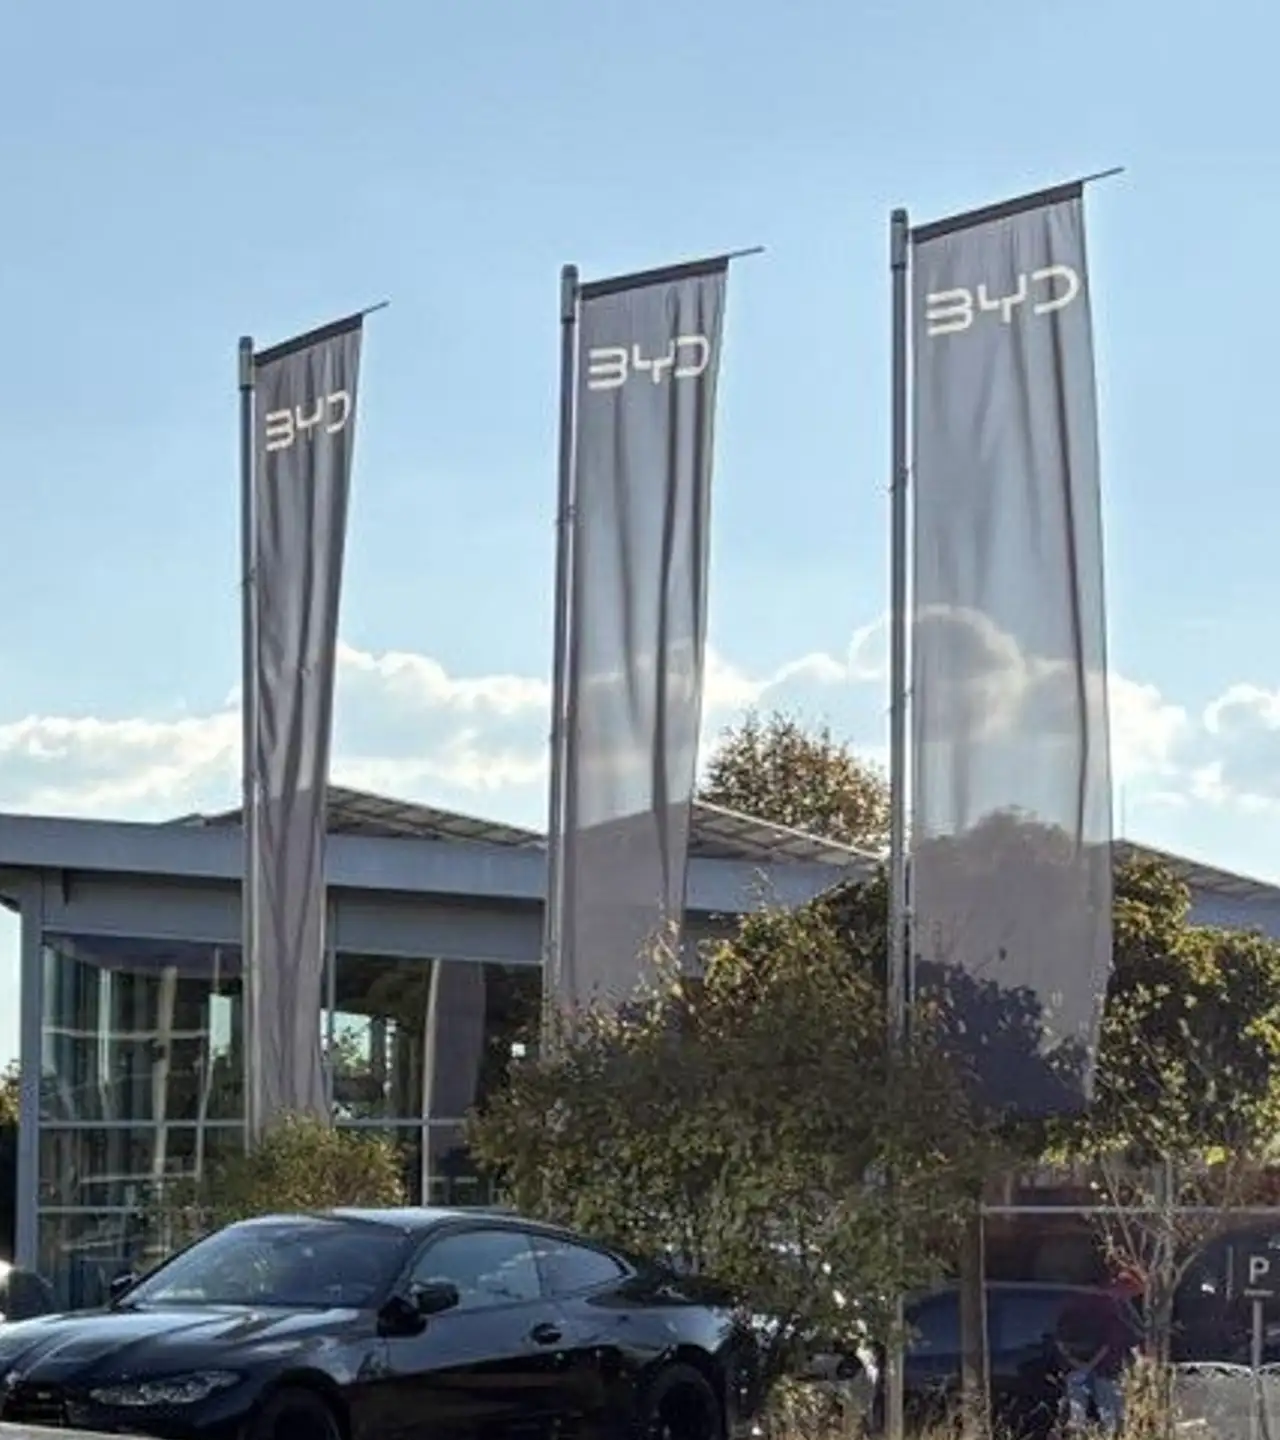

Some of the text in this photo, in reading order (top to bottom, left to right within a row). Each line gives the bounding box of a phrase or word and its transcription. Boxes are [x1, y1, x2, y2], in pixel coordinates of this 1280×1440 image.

[926, 265, 1080, 336] BYD
[587, 335, 709, 389] BYD
[266, 390, 350, 451] BYD
[1249, 1255, 1271, 1285] P
